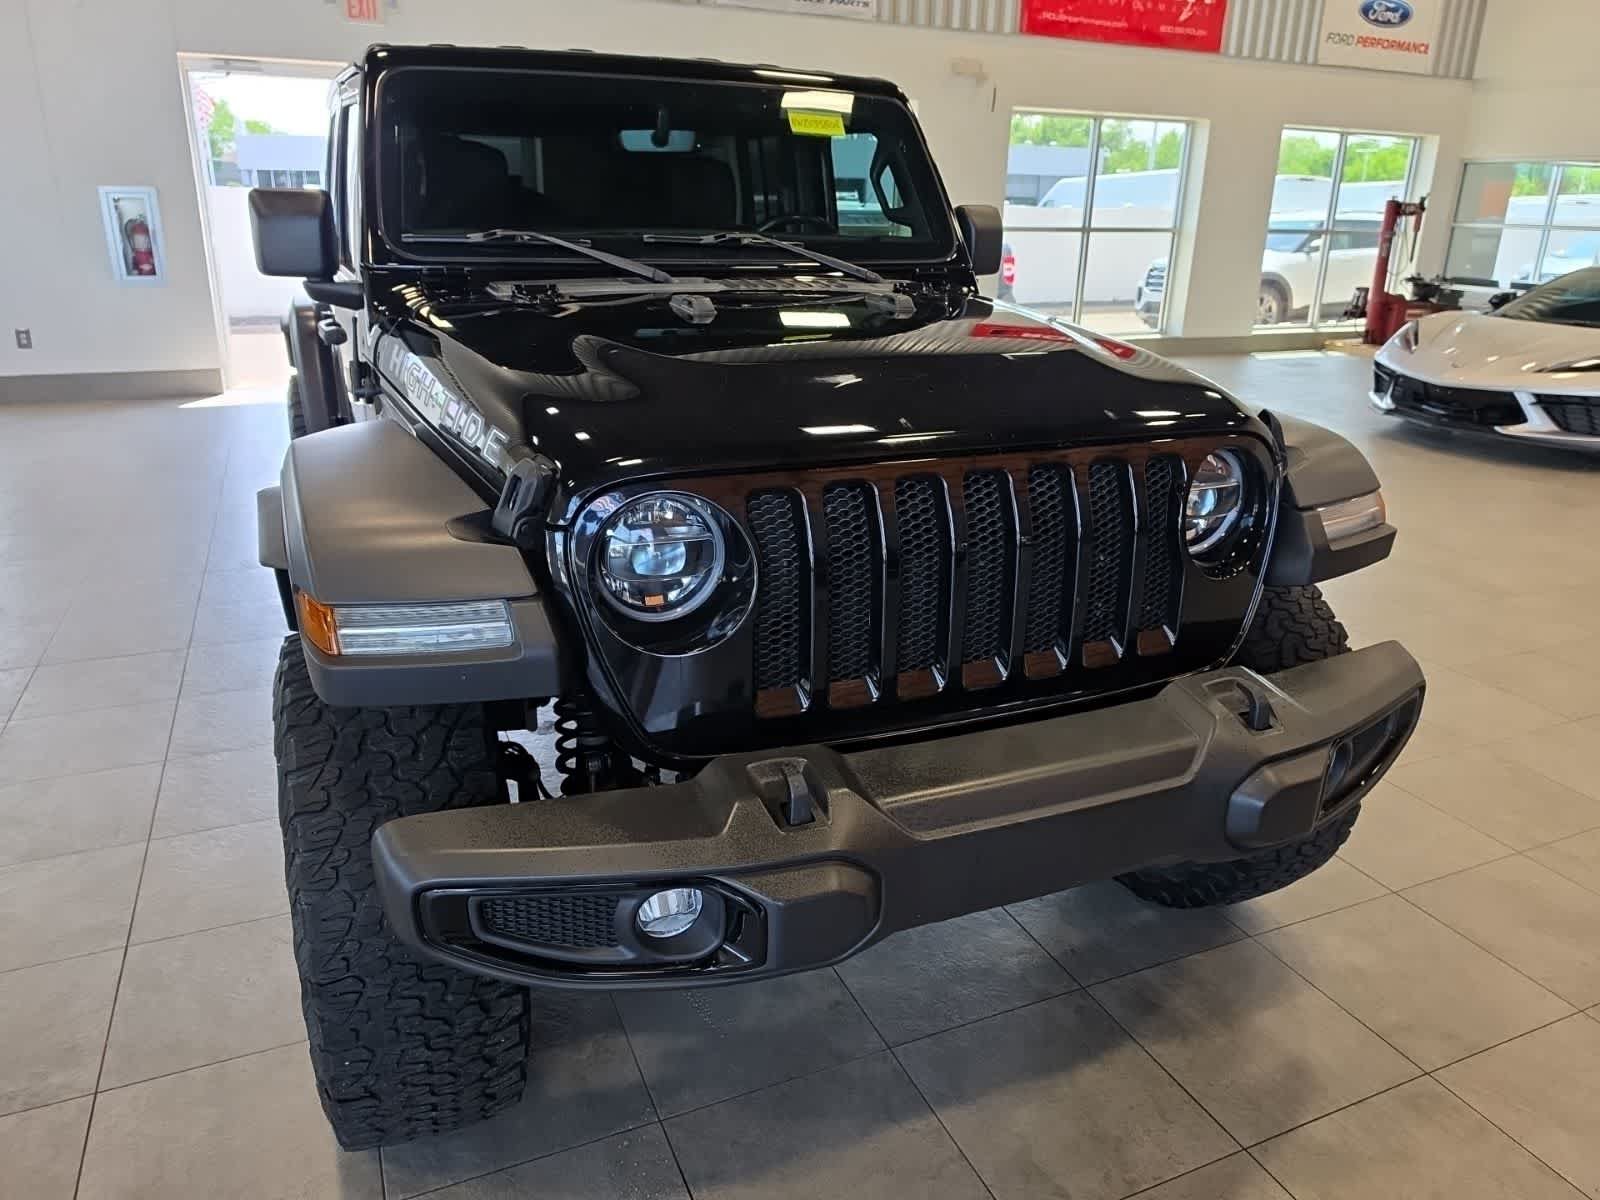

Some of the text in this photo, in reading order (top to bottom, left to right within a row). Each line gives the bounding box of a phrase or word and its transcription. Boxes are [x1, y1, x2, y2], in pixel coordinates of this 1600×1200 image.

[347, 0, 377, 20] EXIT
[1367, 0, 1405, 23] Ford
[1326, 31, 1430, 55] FORD PERFORMANCE
